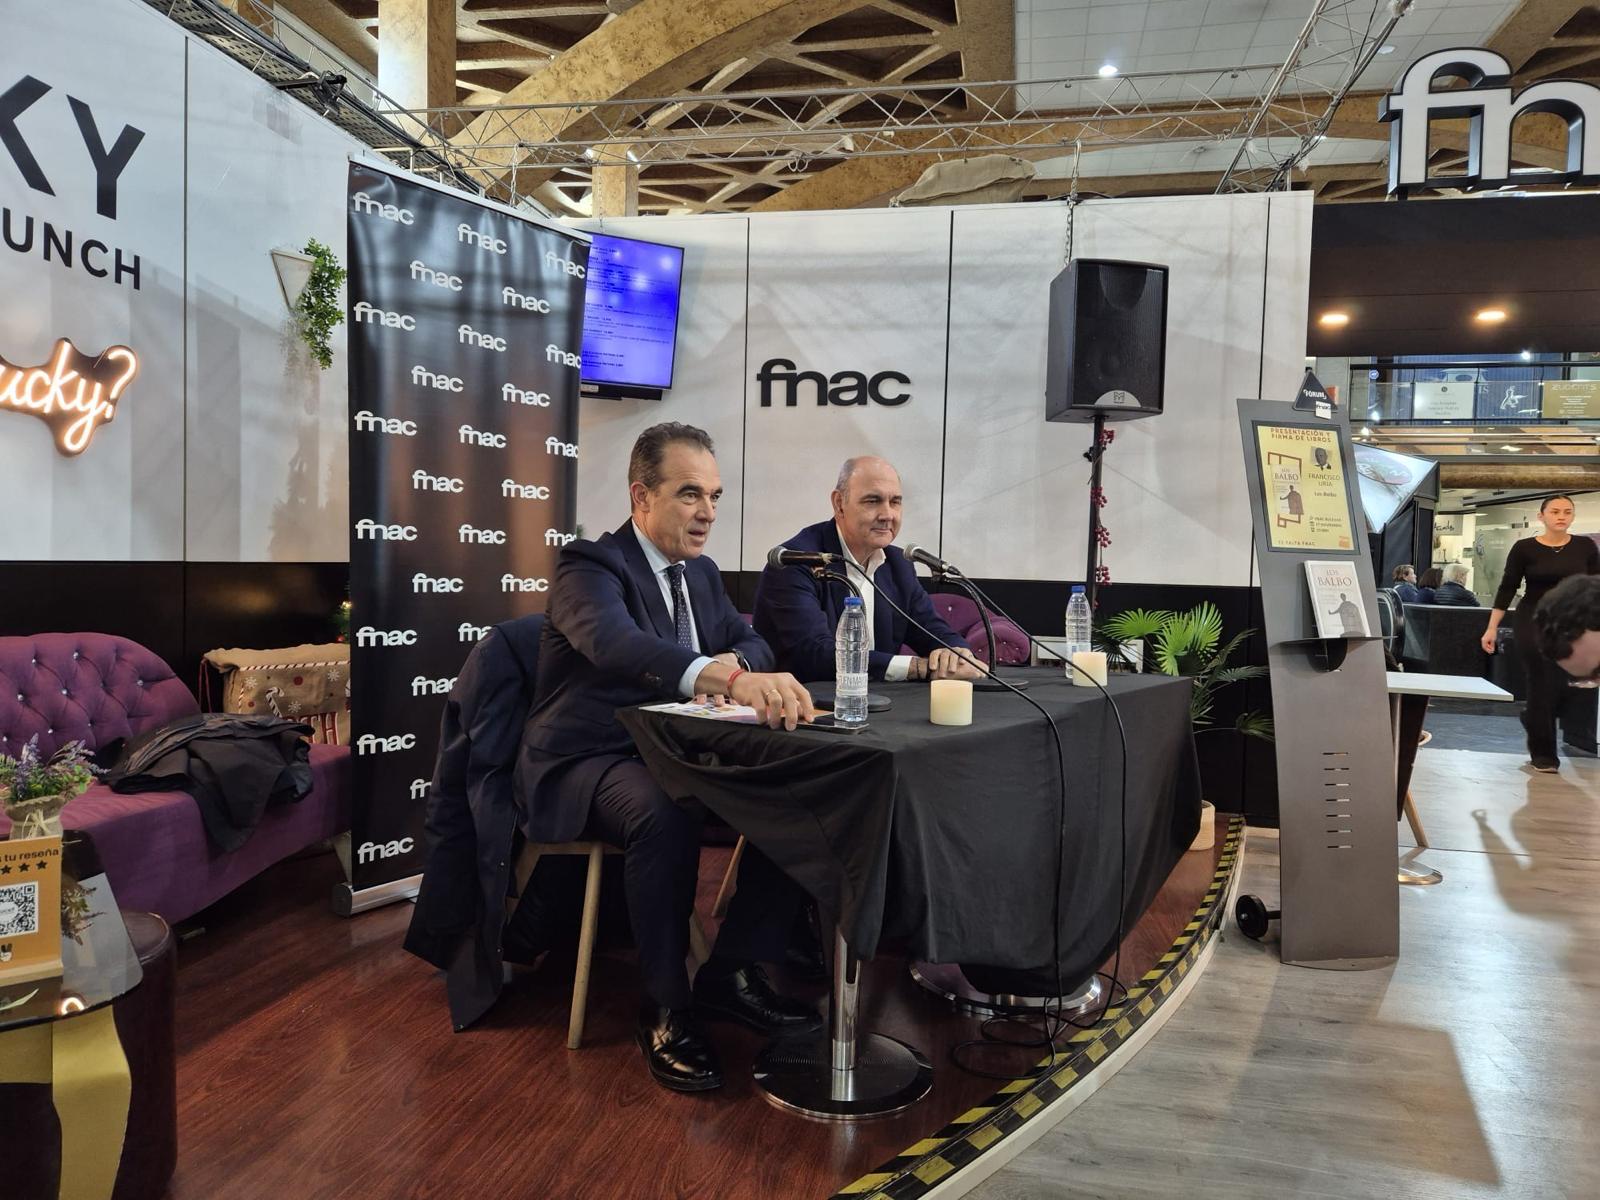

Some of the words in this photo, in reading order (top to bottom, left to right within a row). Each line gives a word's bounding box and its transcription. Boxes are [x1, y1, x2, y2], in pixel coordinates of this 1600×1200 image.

[353, 192, 414, 225] fnac
[3, 207, 140, 291] UNCH
[458, 223, 507, 254] fnac
[410, 261, 463, 291] fnac
[545, 252, 586, 279] fnac
[502, 287, 550, 314] fnac
[354, 302, 417, 331] fnac
[458, 325, 507, 352] fnac
[411, 366, 464, 392] fnac
[757, 358, 911, 407] fnac
[502, 383, 551, 407] fnac
[354, 411, 417, 436] fnac
[459, 425, 507, 448] fnac
[412, 470, 464, 493] fnac
[502, 479, 550, 500] fnac
[355, 519, 418, 541] fnac
[459, 524, 506, 544] fnac
[412, 573, 464, 593] fnac
[501, 574, 549, 592] fnac
[356, 627, 417, 647] fnac
[357, 734, 416, 755] fnac
[4, 854, 17, 862] tu
[18, 848, 59, 860] reseña
[357, 837, 414, 864] fnac
